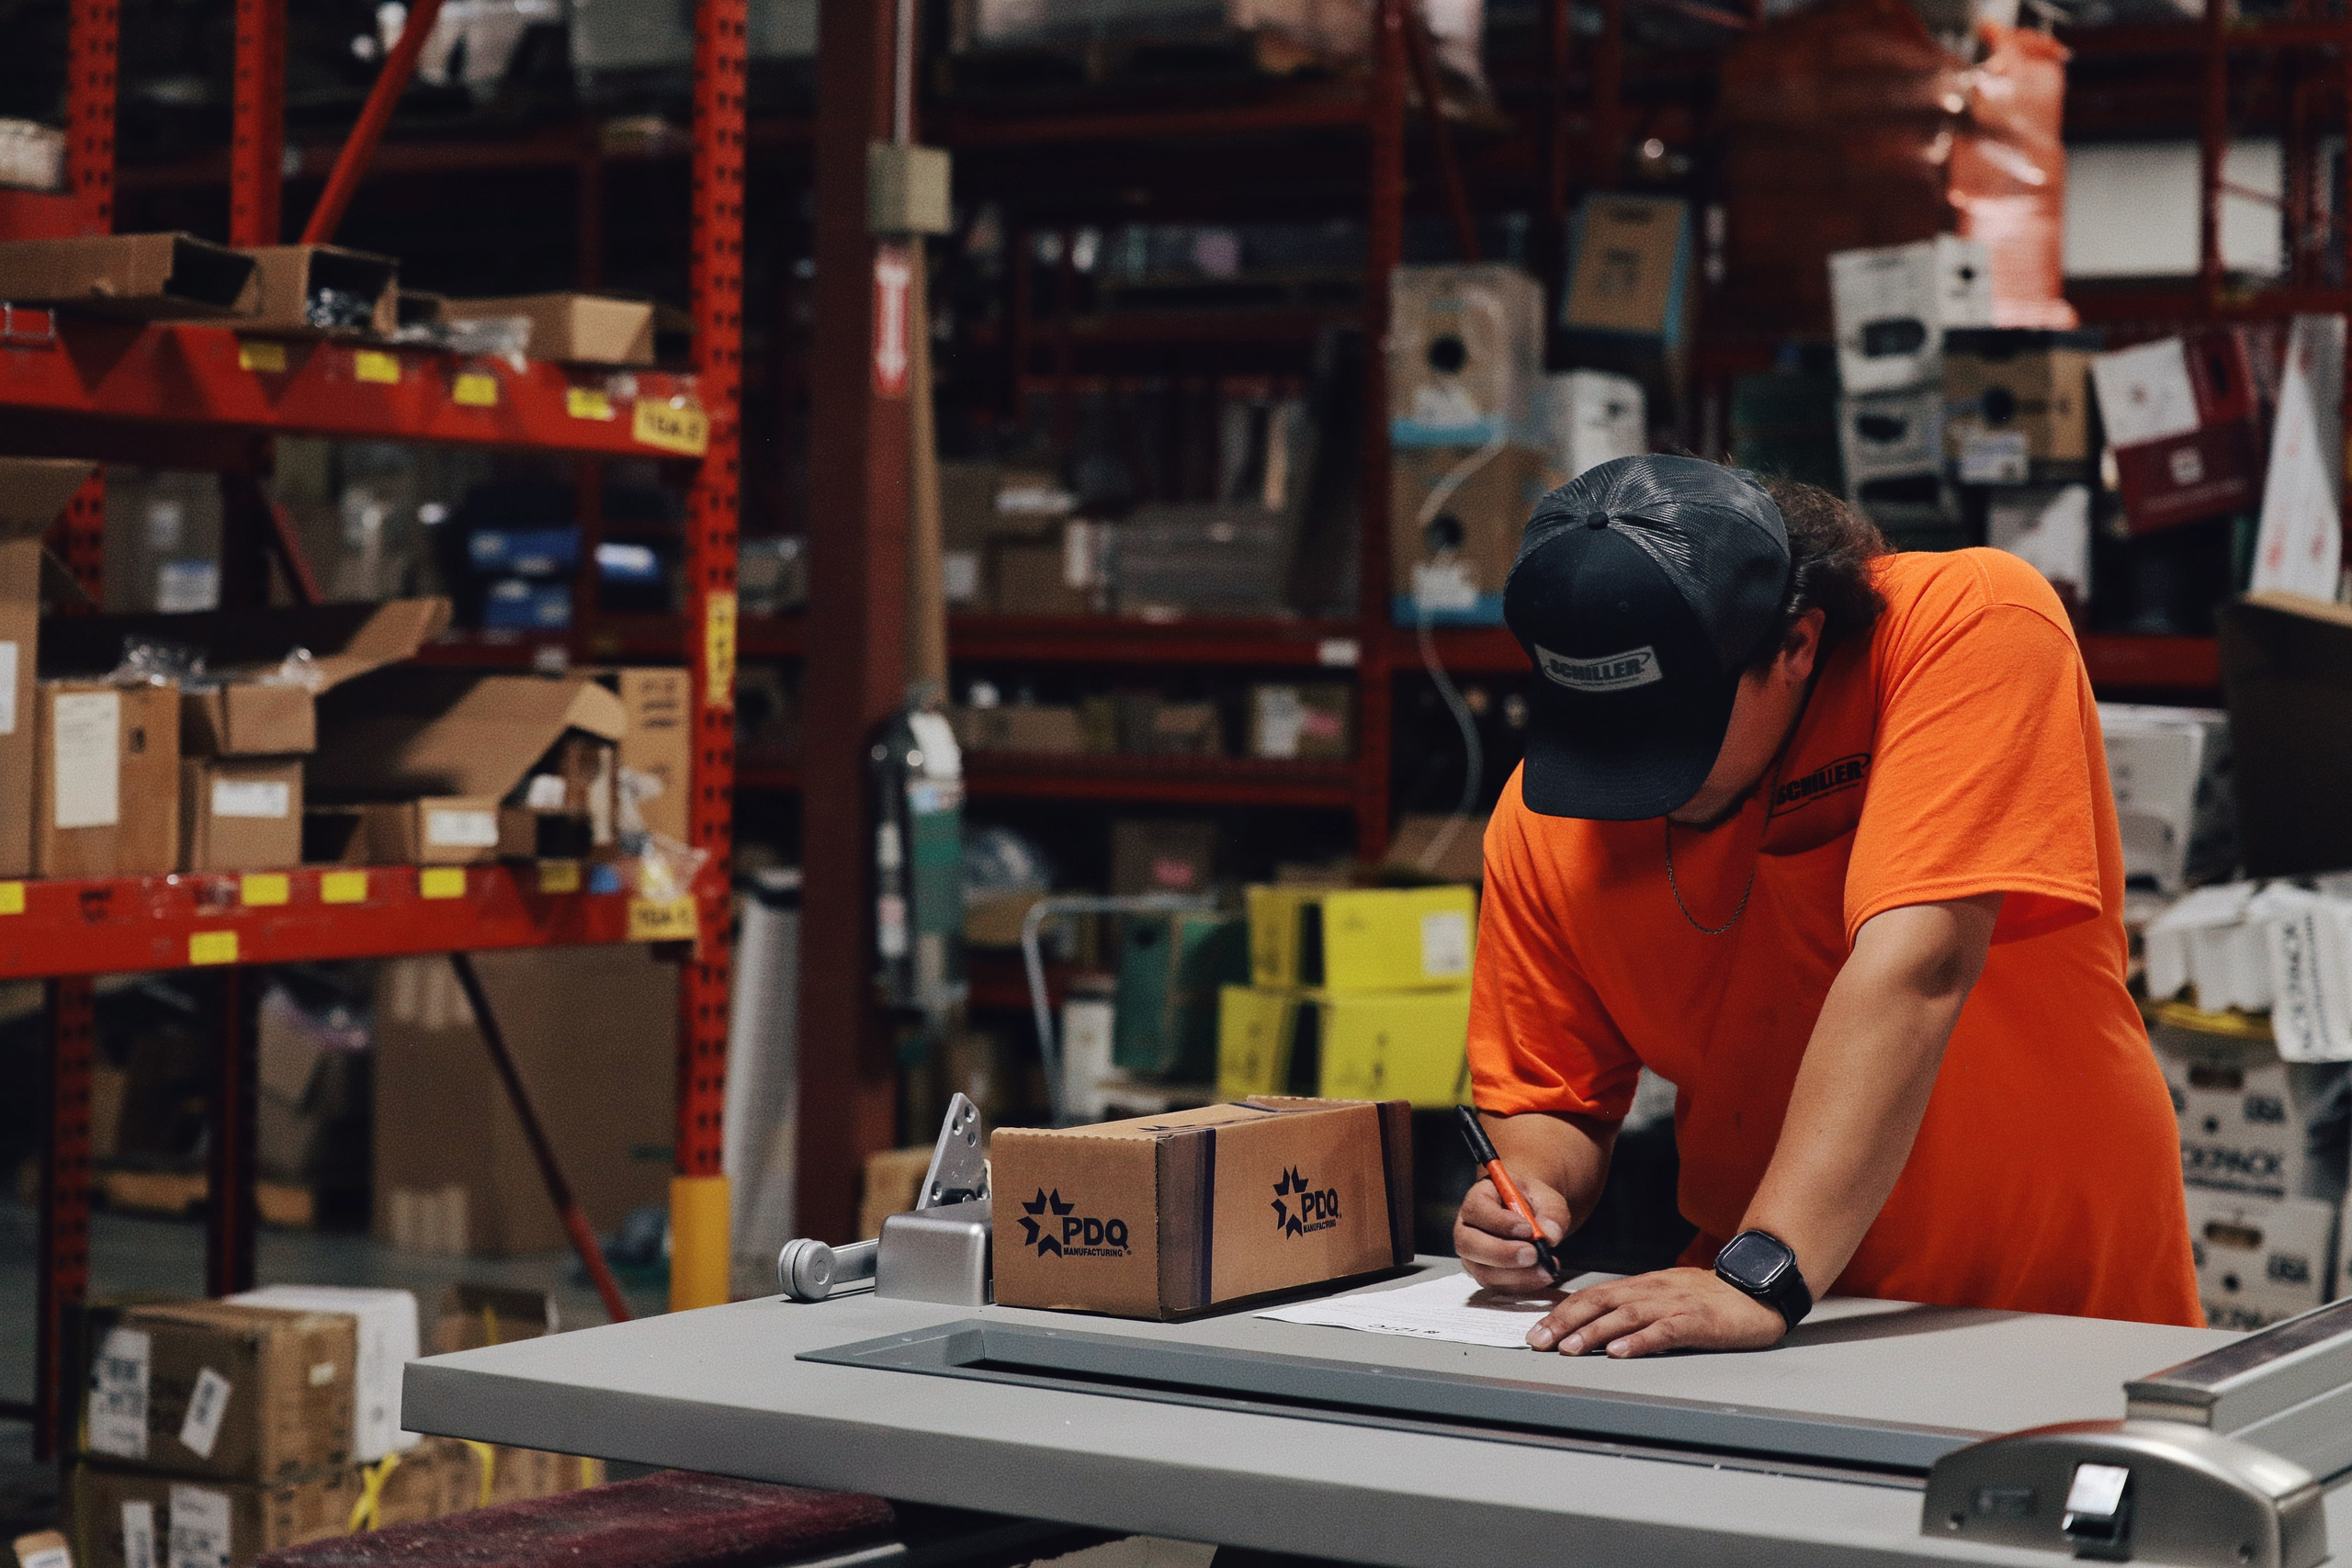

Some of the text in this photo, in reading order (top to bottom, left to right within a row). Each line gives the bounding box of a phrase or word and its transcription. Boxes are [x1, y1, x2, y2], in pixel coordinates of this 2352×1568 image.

[1550, 658, 1642, 682] SCHILLER
[1776, 761, 1862, 806] SCHILLER
[1301, 1188, 1339, 1223] PDQ
[1062, 1217, 1128, 1250] PDQ
[1063, 1247, 1123, 1257] MANUFACTURING
